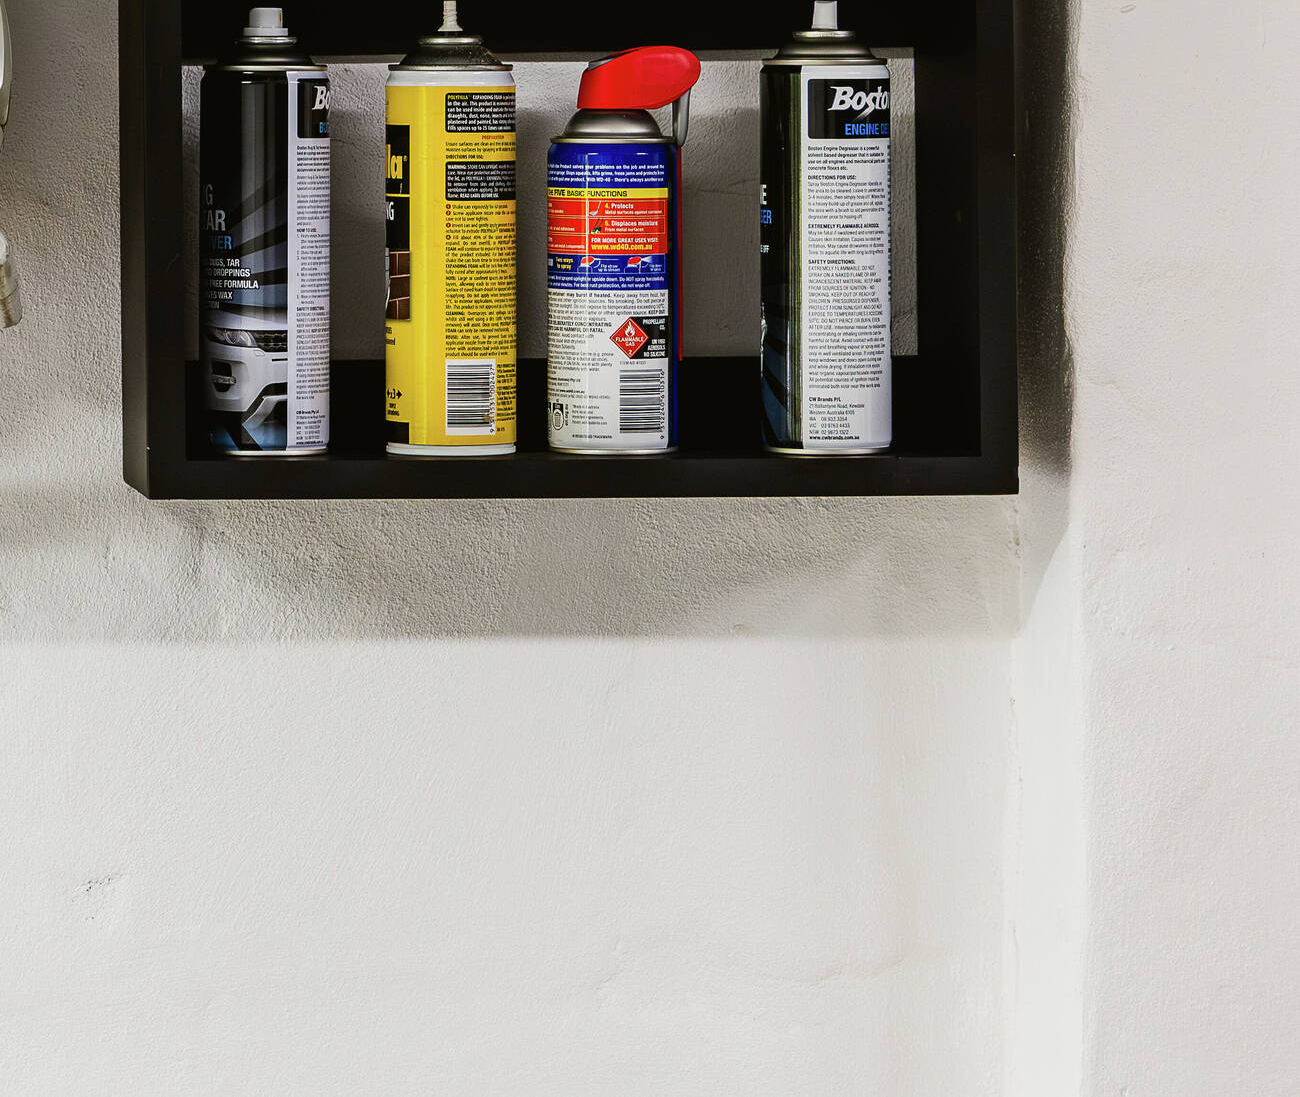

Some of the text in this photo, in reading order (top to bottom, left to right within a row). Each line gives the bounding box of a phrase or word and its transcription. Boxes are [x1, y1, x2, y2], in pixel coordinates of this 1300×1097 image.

[827, 86, 890, 116] Bosto
[319, 122, 330, 134] BU
[845, 123, 879, 136] ENGINE
[205, 209, 226, 232] AR
[226, 258, 240, 267] TAR
[213, 267, 251, 278] DROPPINGS
[223, 280, 259, 290] FORMULA
[217, 290, 233, 300] WAX
